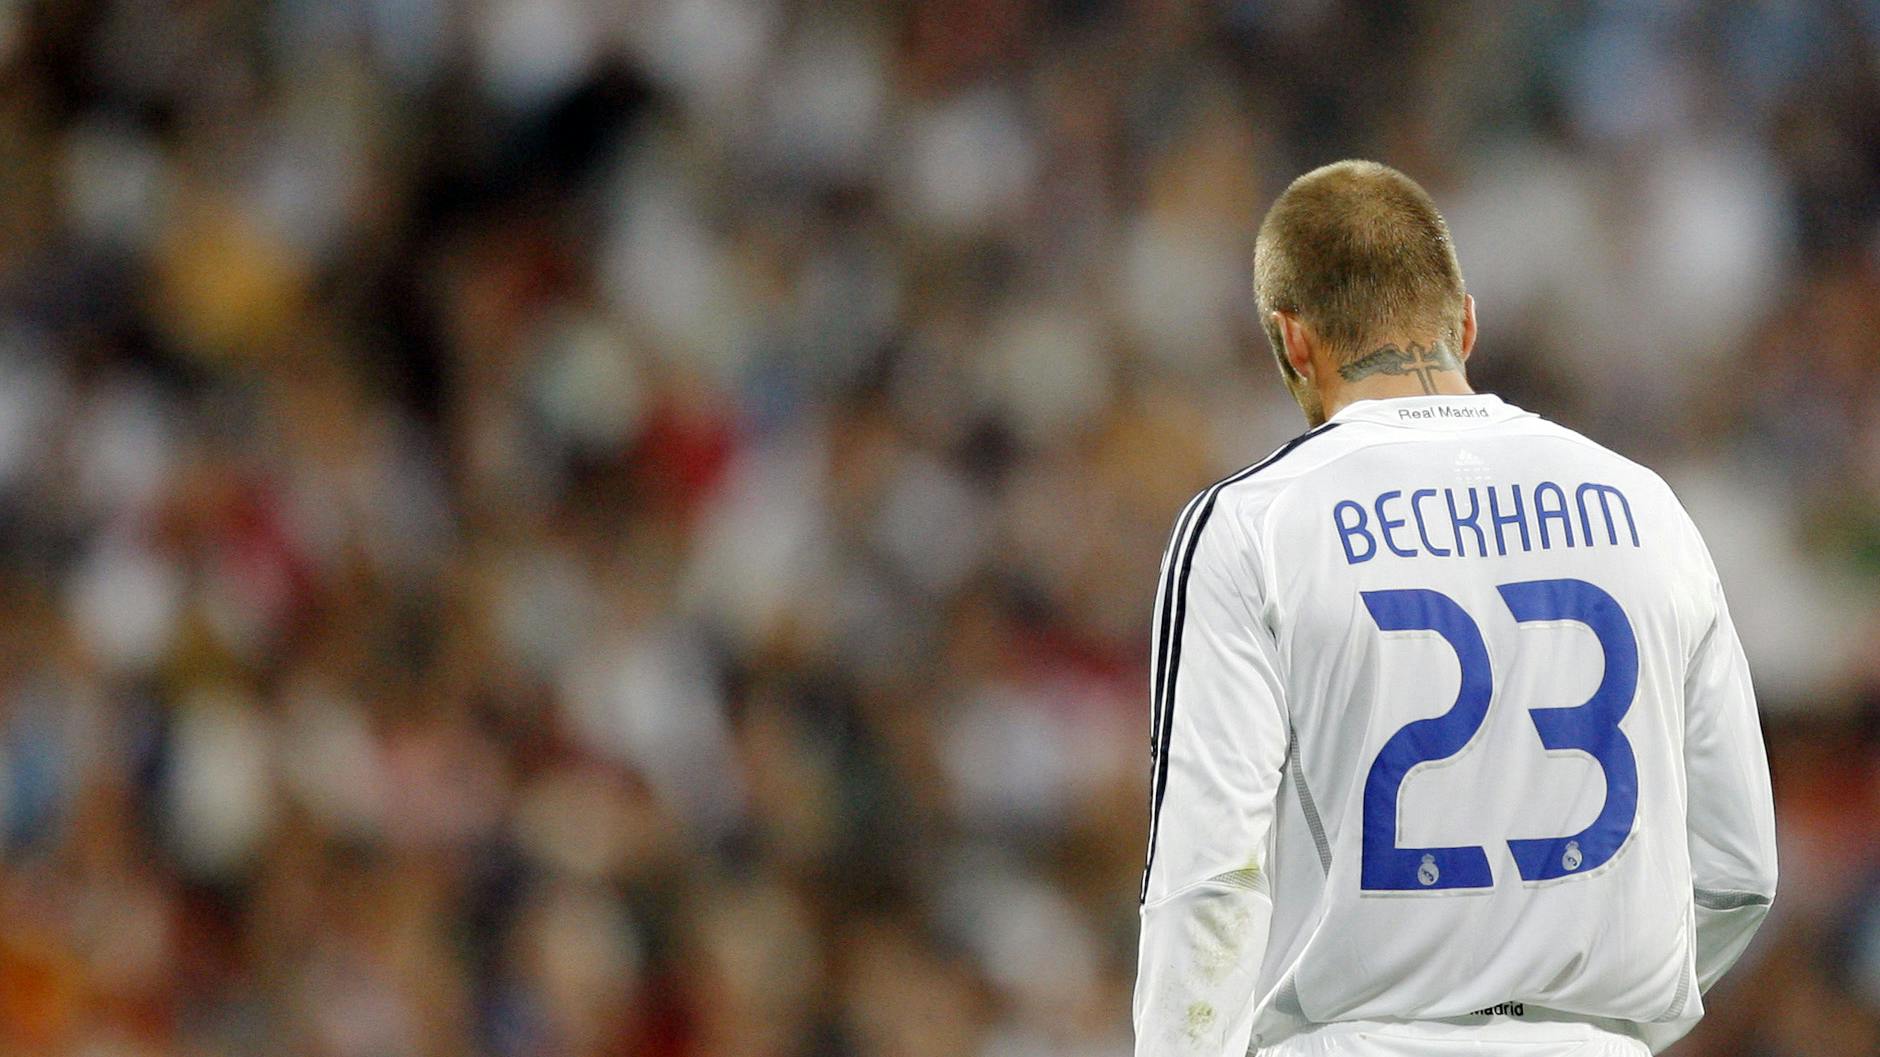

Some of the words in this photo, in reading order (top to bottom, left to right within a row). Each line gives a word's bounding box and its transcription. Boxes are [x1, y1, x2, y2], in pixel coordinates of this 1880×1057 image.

[1398, 407, 1436, 420] Real
[1438, 405, 1489, 418] Madrid
[1334, 481, 1640, 565] BECKHAM
[1360, 578, 1639, 891] 23
